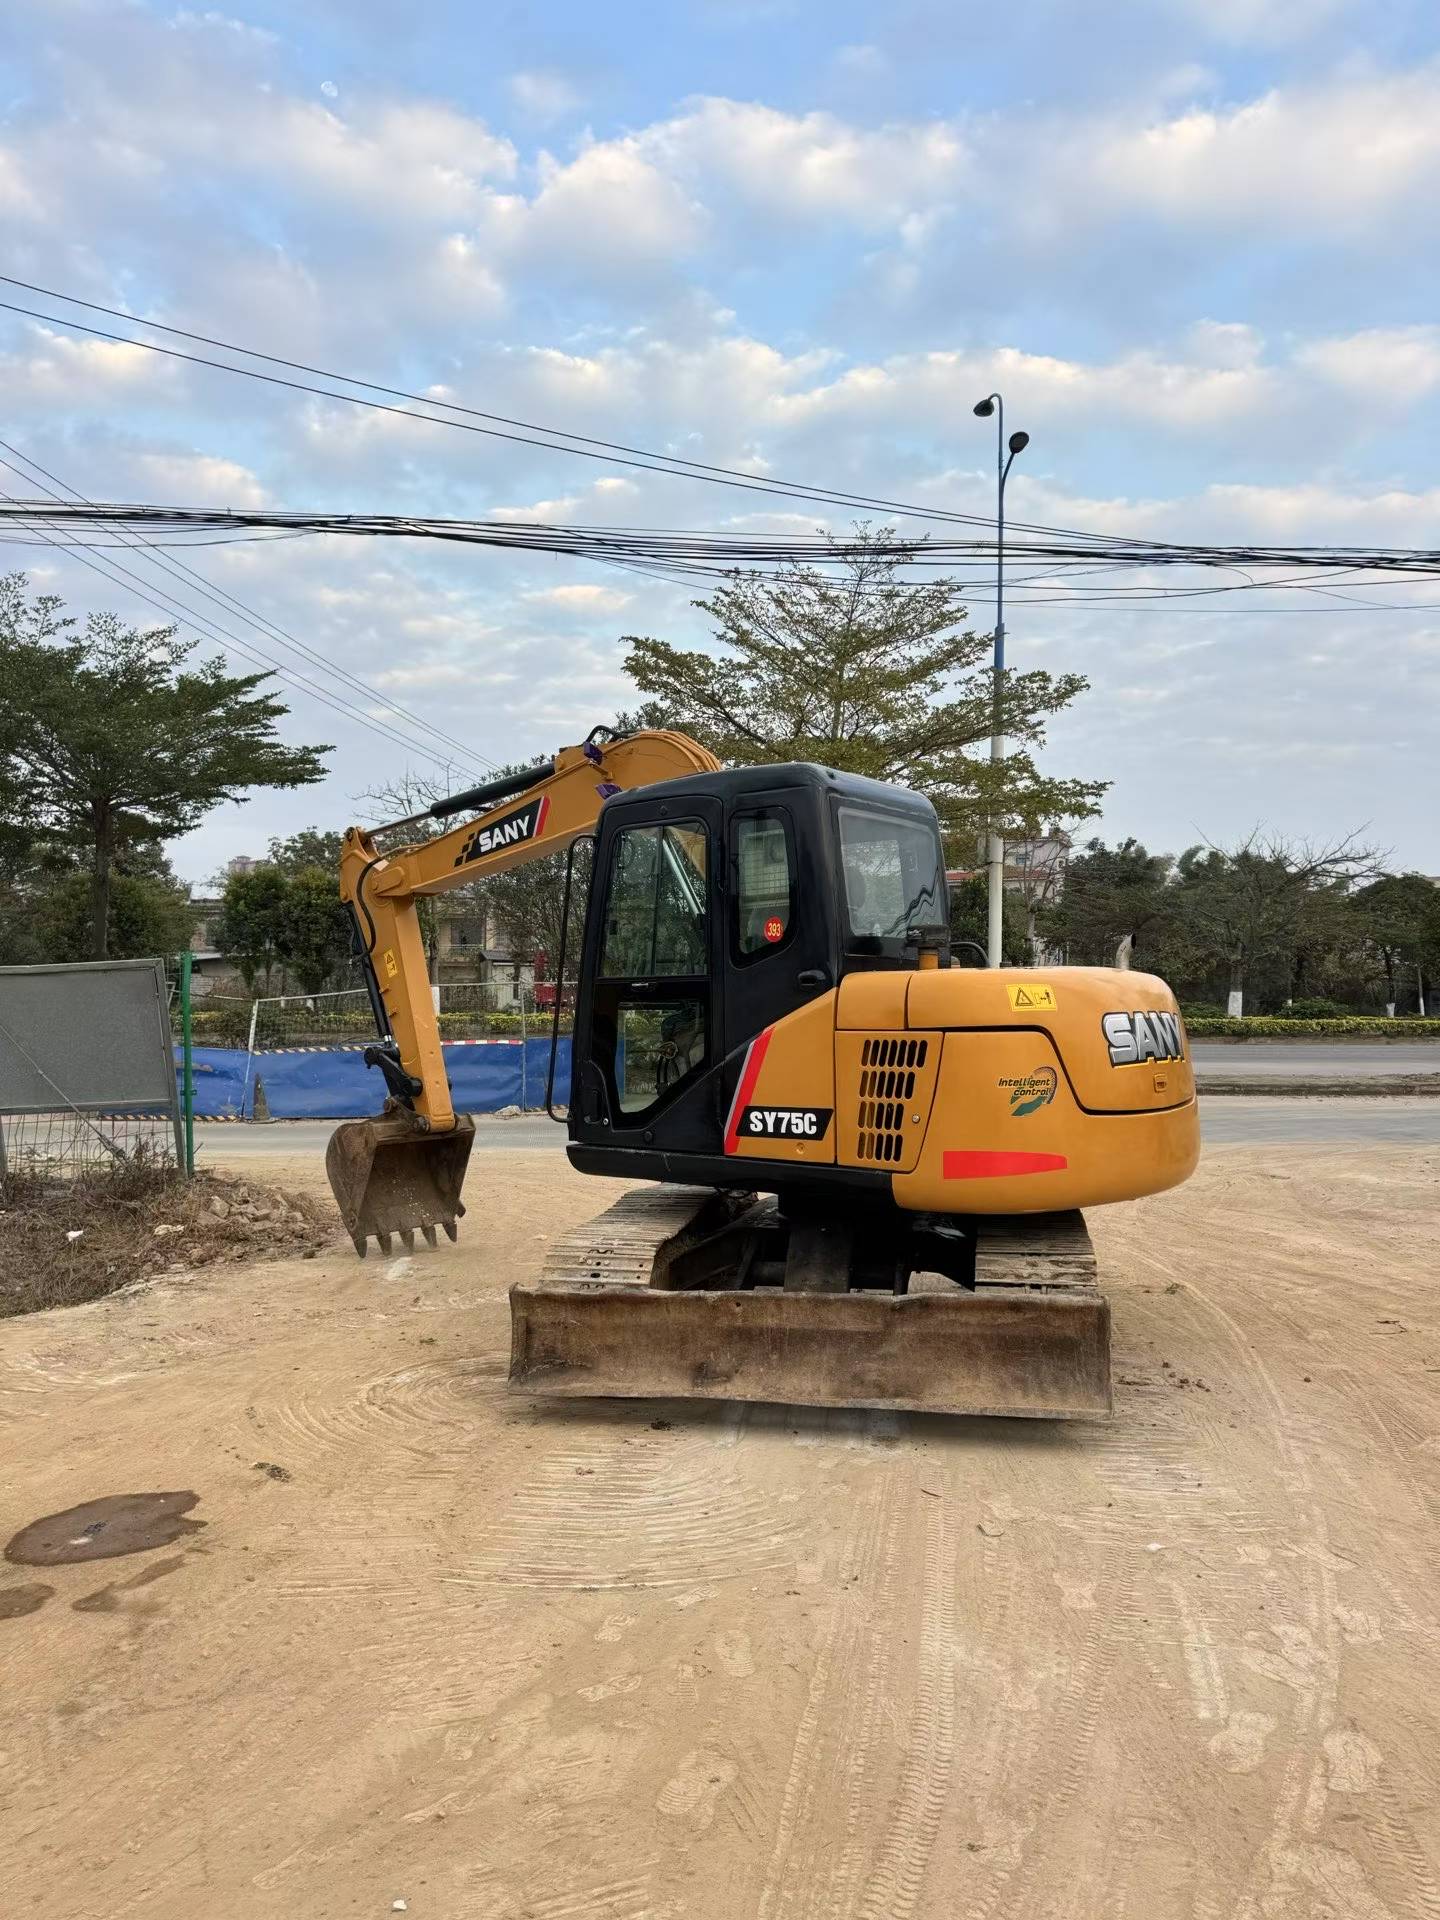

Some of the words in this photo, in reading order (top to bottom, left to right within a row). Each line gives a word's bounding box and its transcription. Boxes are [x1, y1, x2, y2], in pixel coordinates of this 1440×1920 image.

[478, 815, 530, 853] SANY
[767, 922, 781, 937] 393
[998, 1076, 1051, 1089] Intelligent
[749, 1111, 817, 1135] SY75C
